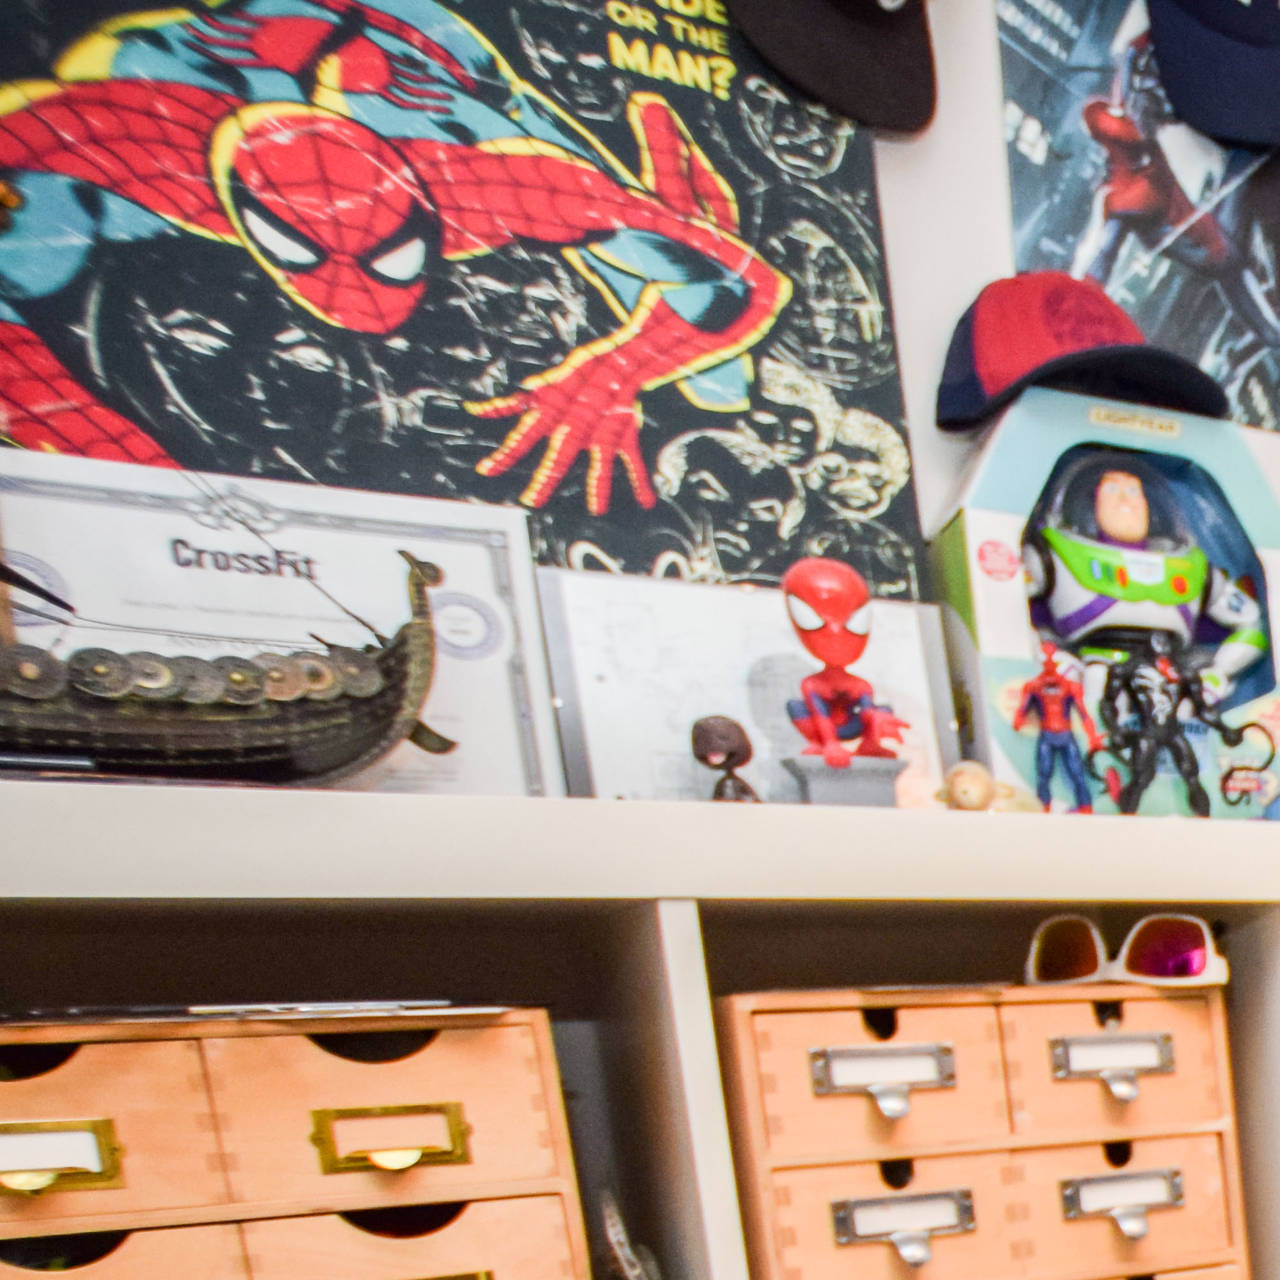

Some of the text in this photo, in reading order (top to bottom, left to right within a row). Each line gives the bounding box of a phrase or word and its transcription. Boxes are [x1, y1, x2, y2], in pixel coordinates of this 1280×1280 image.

[606, 1, 660, 36] OR
[663, 14, 732, 56] THE
[607, 31, 737, 101] MAN?
[170, 537, 318, 582] CrossFit
